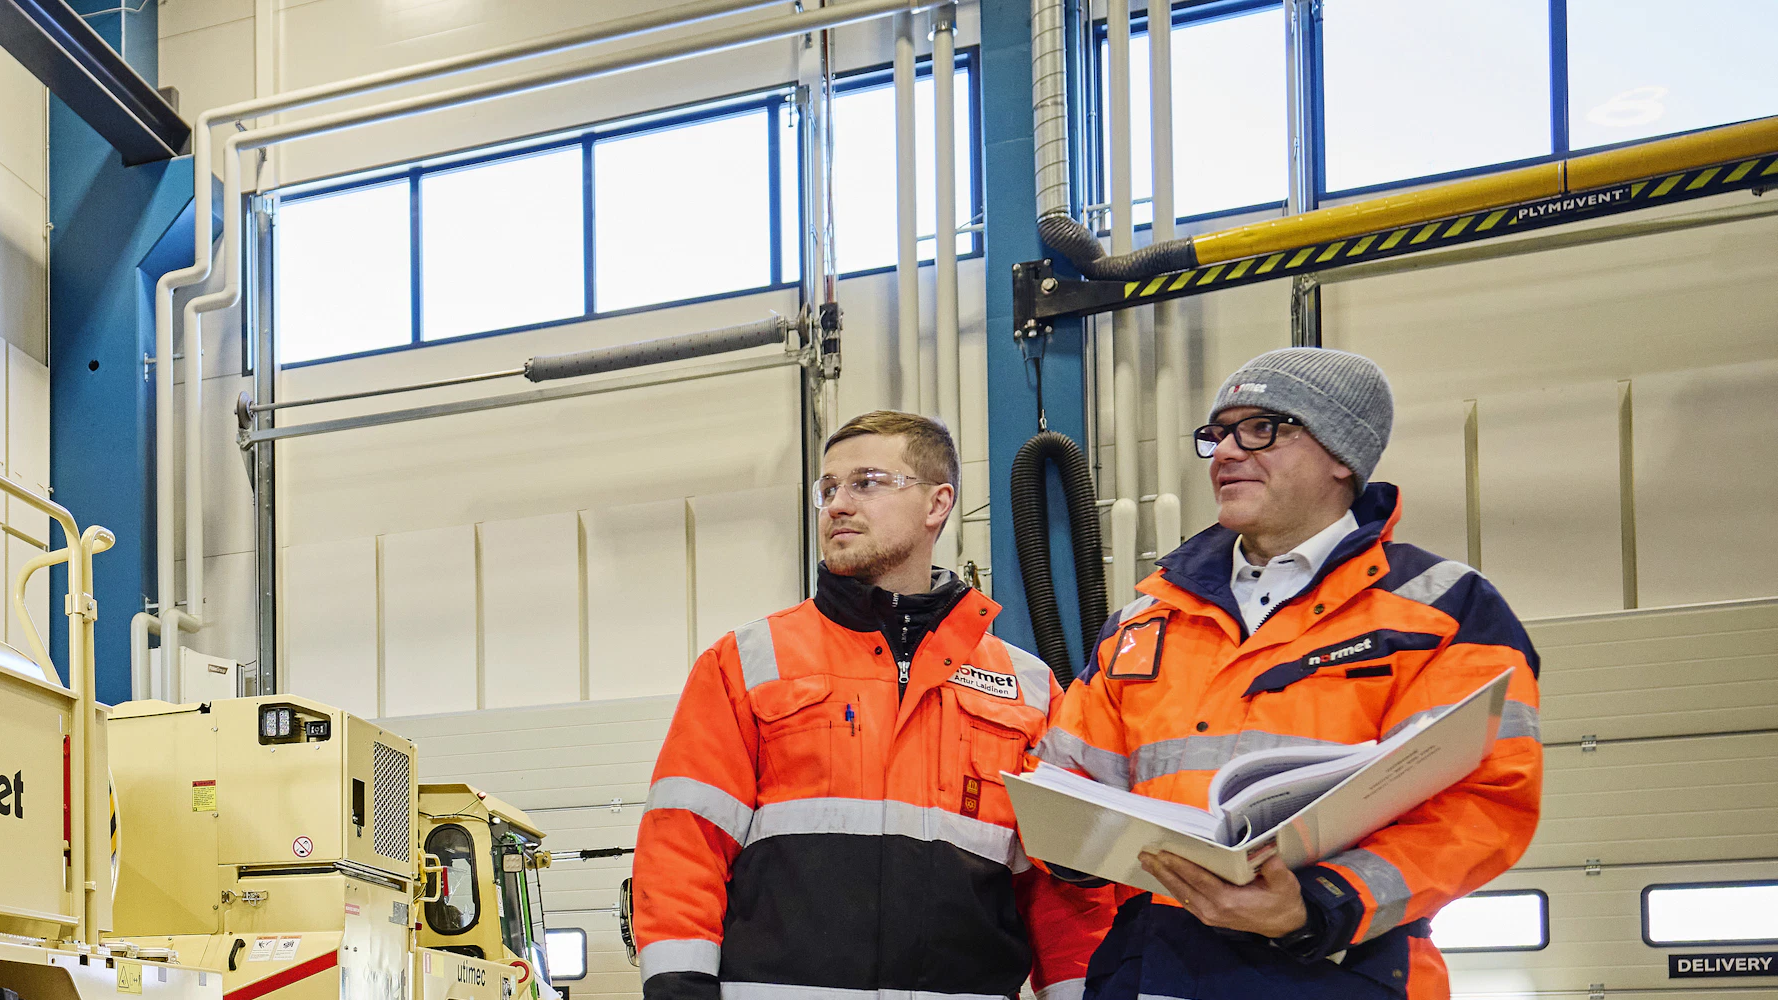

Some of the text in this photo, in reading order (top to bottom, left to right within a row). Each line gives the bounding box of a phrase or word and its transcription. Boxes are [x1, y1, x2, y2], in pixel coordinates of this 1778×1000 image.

[1518, 189, 1624, 219] PLYMOVENT
[1308, 638, 1372, 666] normet
[954, 675, 974, 685] Artur
[458, 960, 486, 987] utimec
[1677, 957, 1773, 973] DELIVERY
